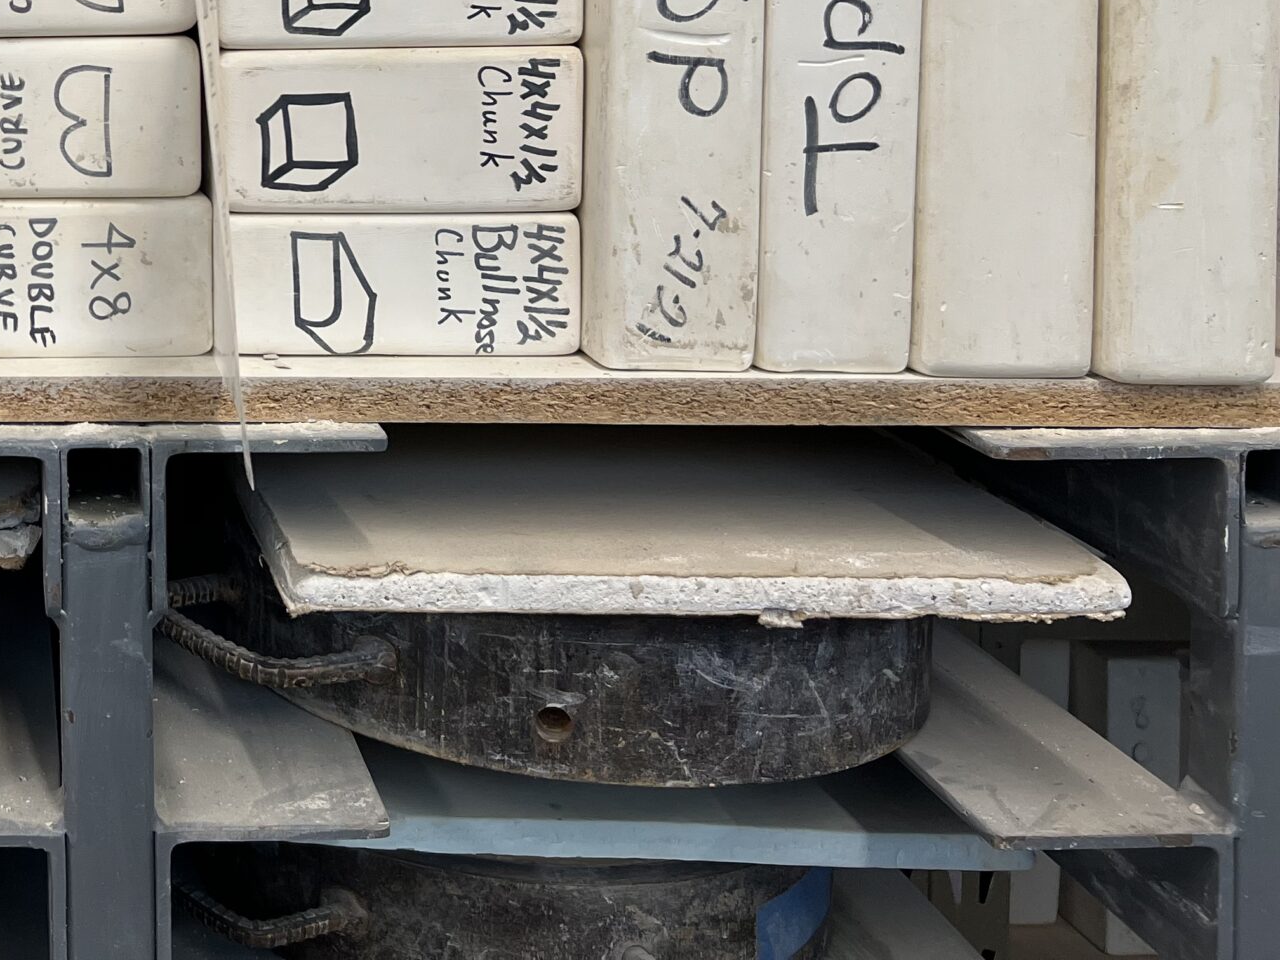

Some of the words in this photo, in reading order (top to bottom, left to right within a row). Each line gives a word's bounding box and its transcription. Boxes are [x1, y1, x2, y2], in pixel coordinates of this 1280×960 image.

[0, 71, 28, 171] CURVE
[476, 65, 517, 169] Chunk
[28, 217, 58, 348] DOUBLE
[433, 227, 477, 327] Chunk
[470, 223, 522, 356] Bullnose
